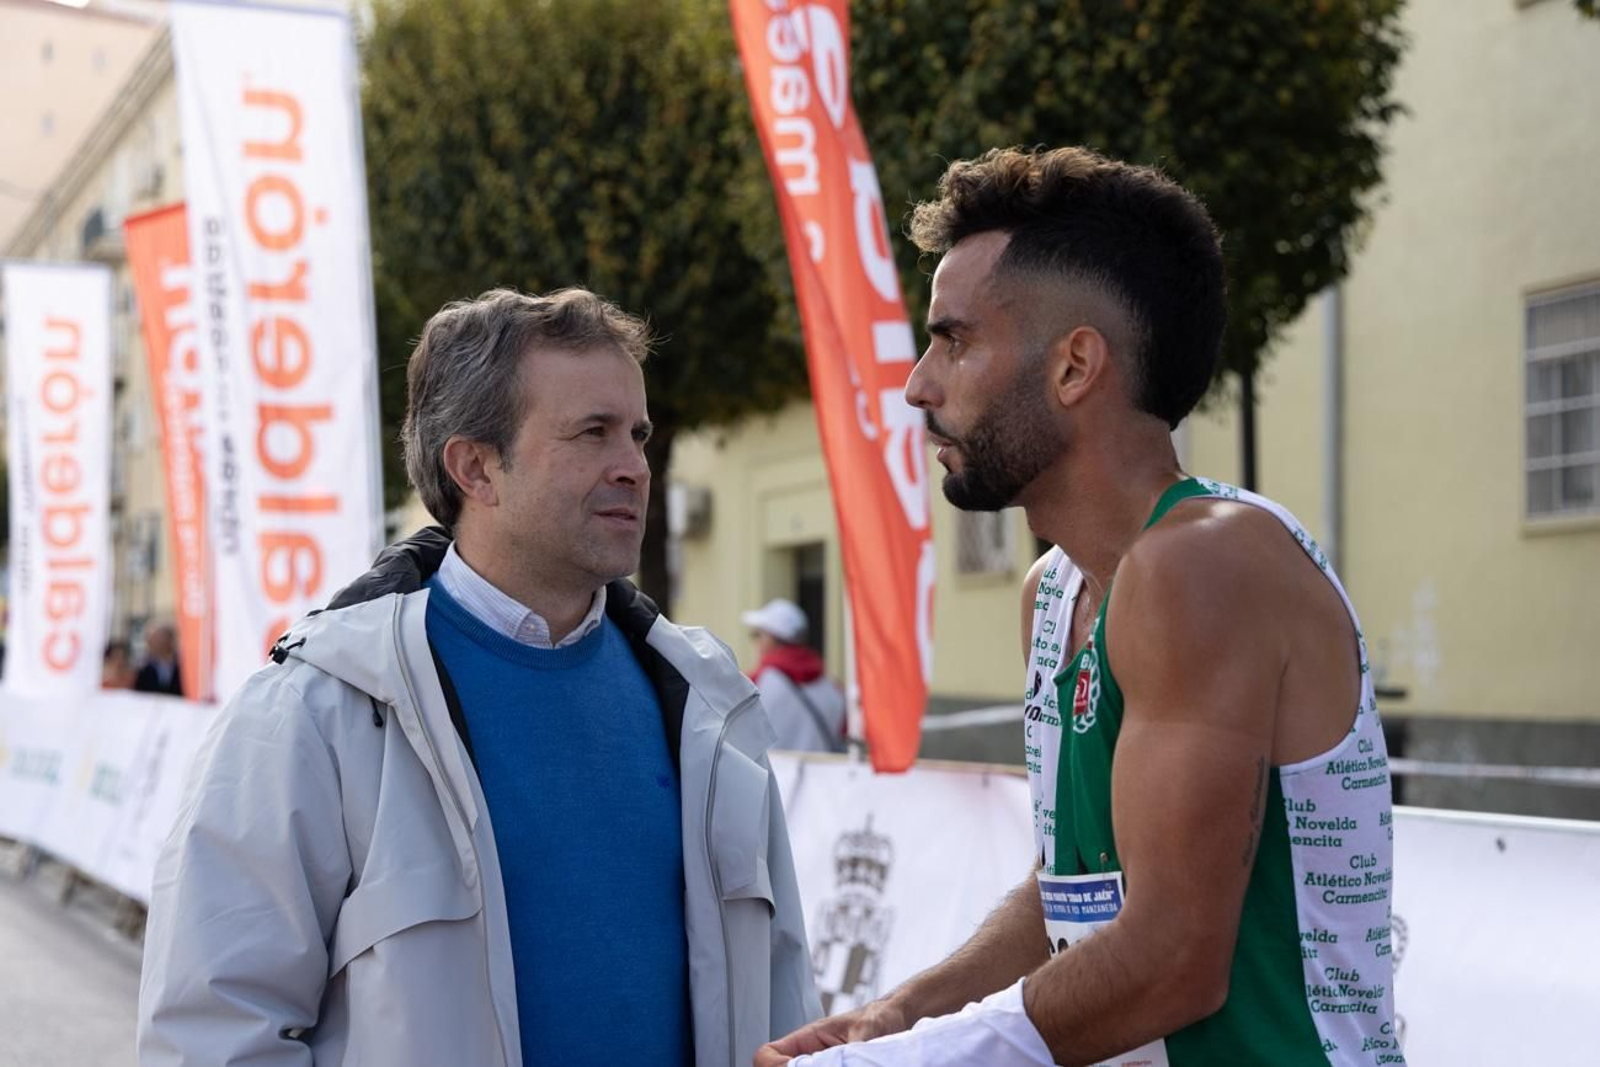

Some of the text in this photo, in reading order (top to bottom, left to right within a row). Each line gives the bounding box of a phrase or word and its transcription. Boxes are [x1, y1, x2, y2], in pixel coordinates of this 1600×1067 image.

[1325, 758, 1368, 775] Atlético
[1284, 797, 1317, 813] lub
[1294, 816, 1358, 831] Novelda
[1290, 835, 1343, 848] encita
[1349, 853, 1377, 870] Club
[1303, 871, 1362, 888] Atlético
[1324, 966, 1360, 983] Club
